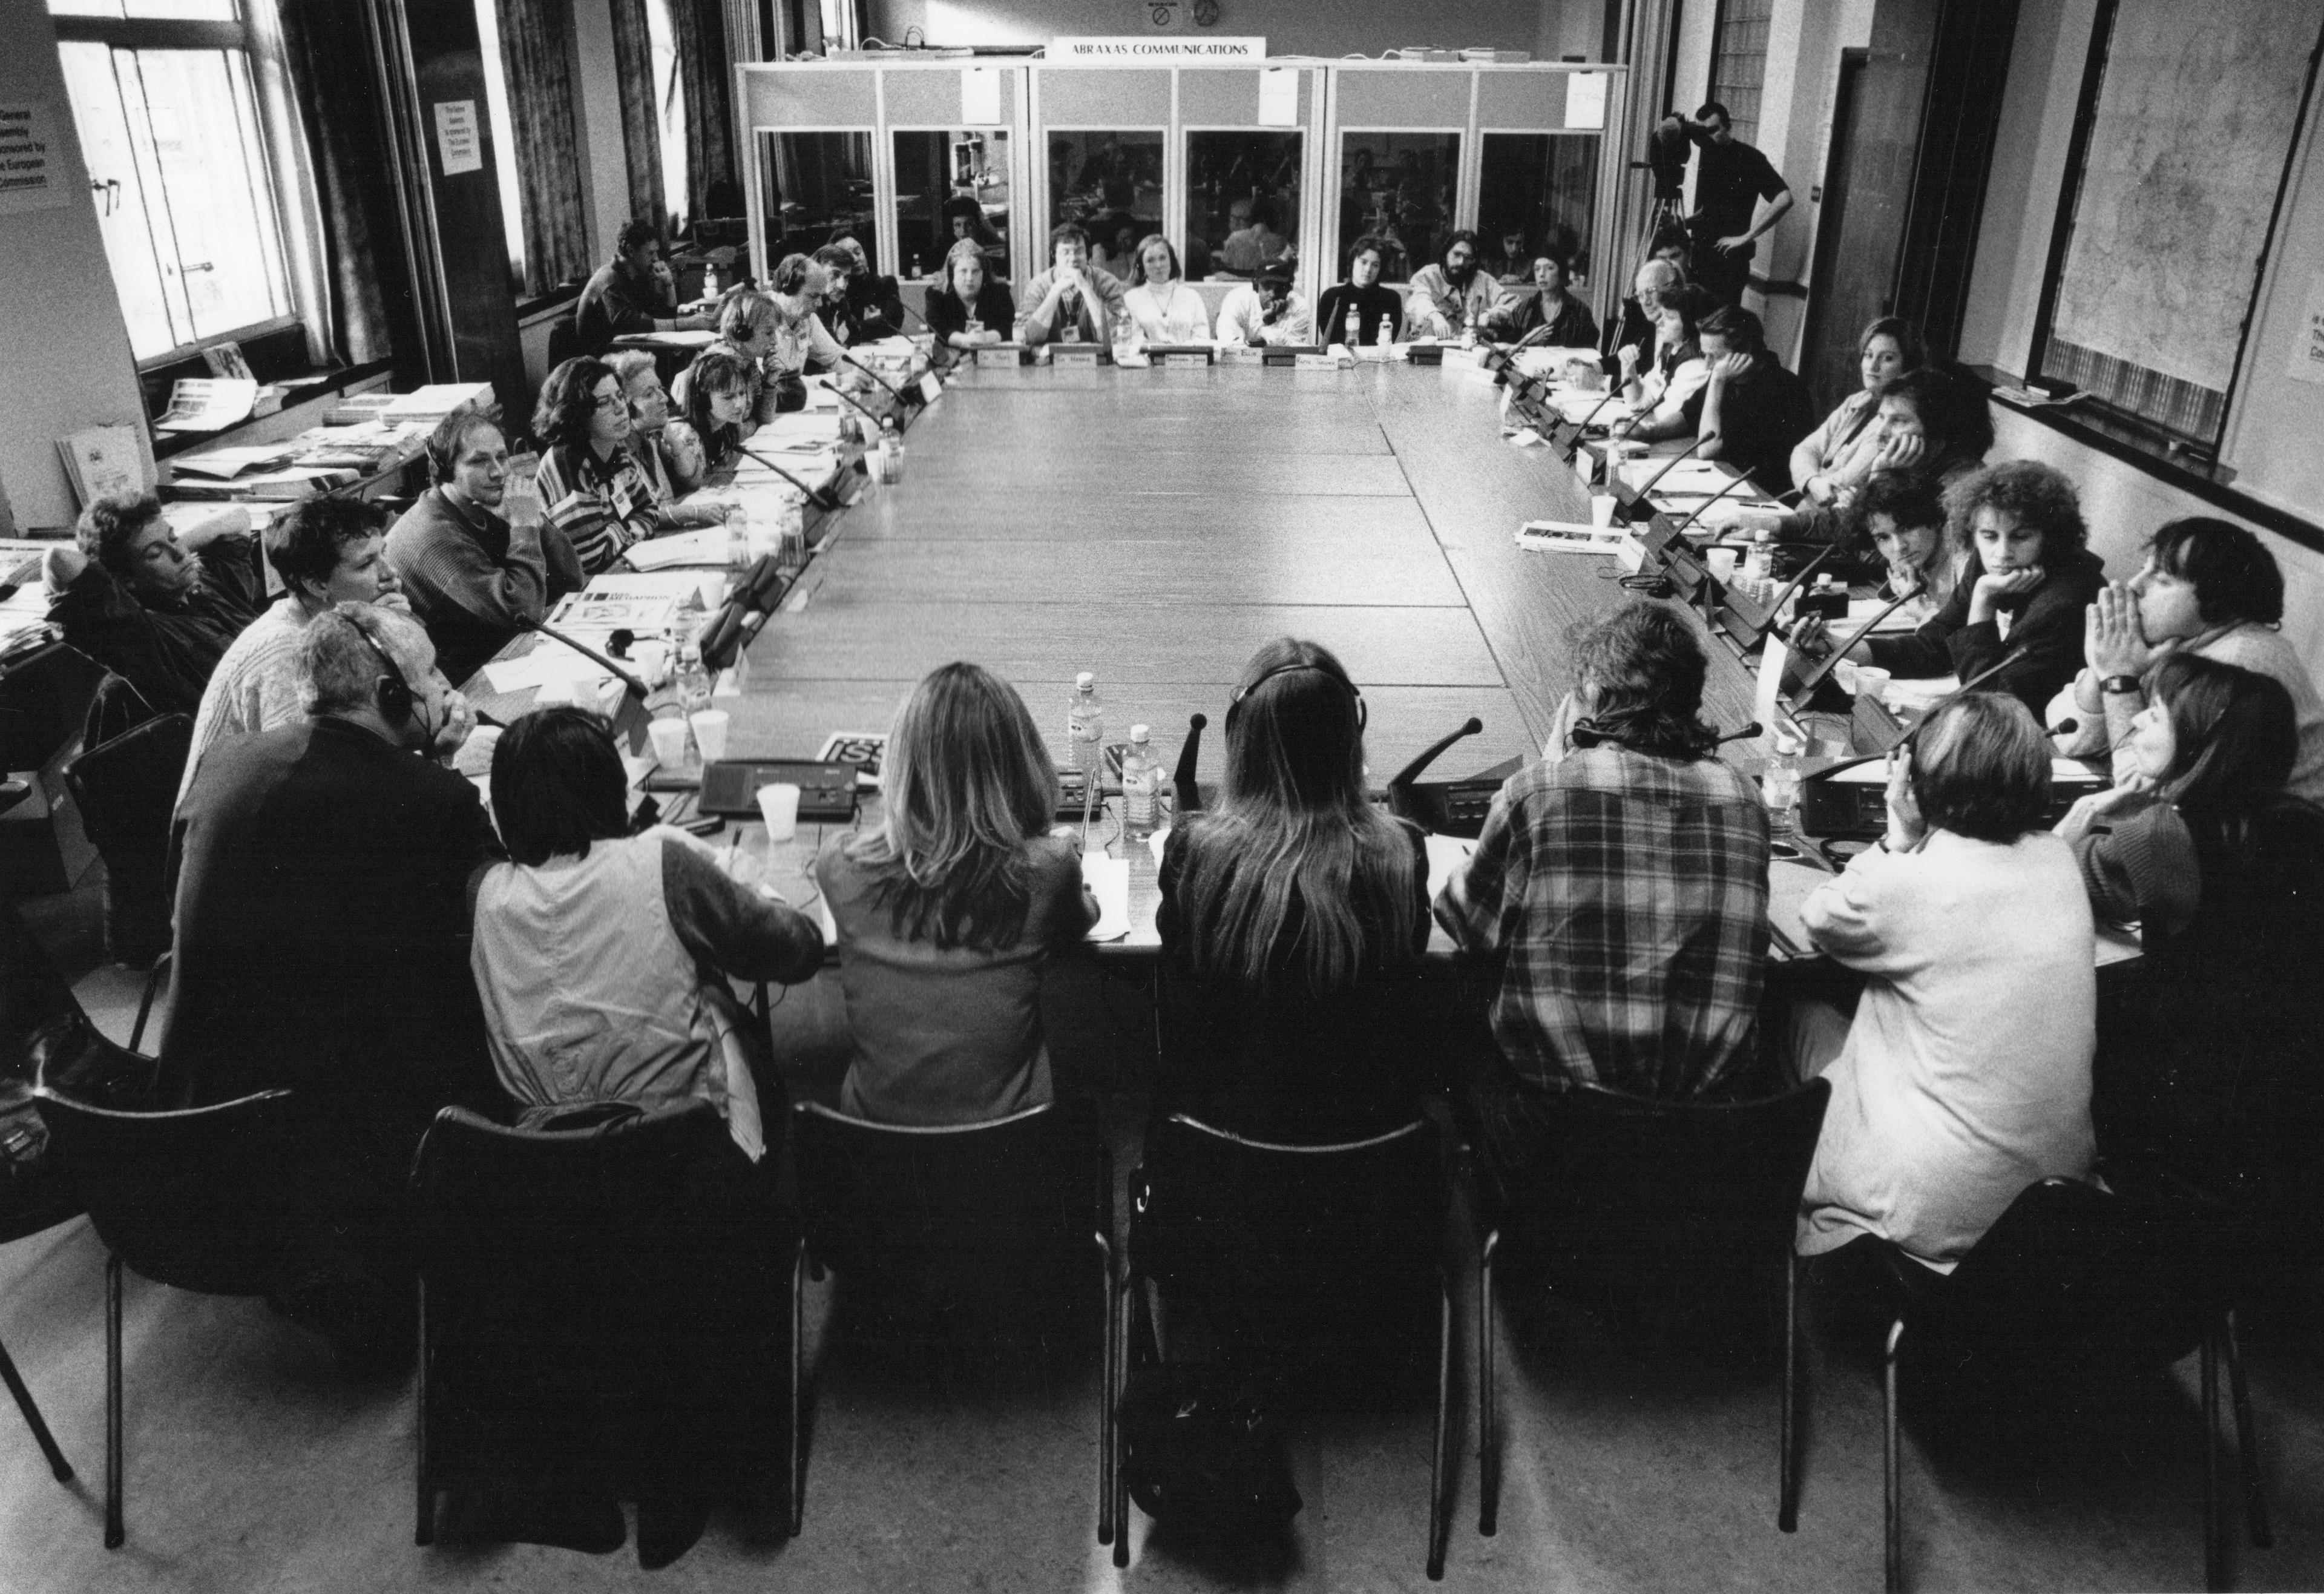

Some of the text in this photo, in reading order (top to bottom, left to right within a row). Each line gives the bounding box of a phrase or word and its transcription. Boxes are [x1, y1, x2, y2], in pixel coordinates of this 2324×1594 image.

[1072, 44, 1249, 55] ABRAXAS COMMUNICATIONS
[0, 141, 33, 154] onsored
[7, 159, 45, 171] European
